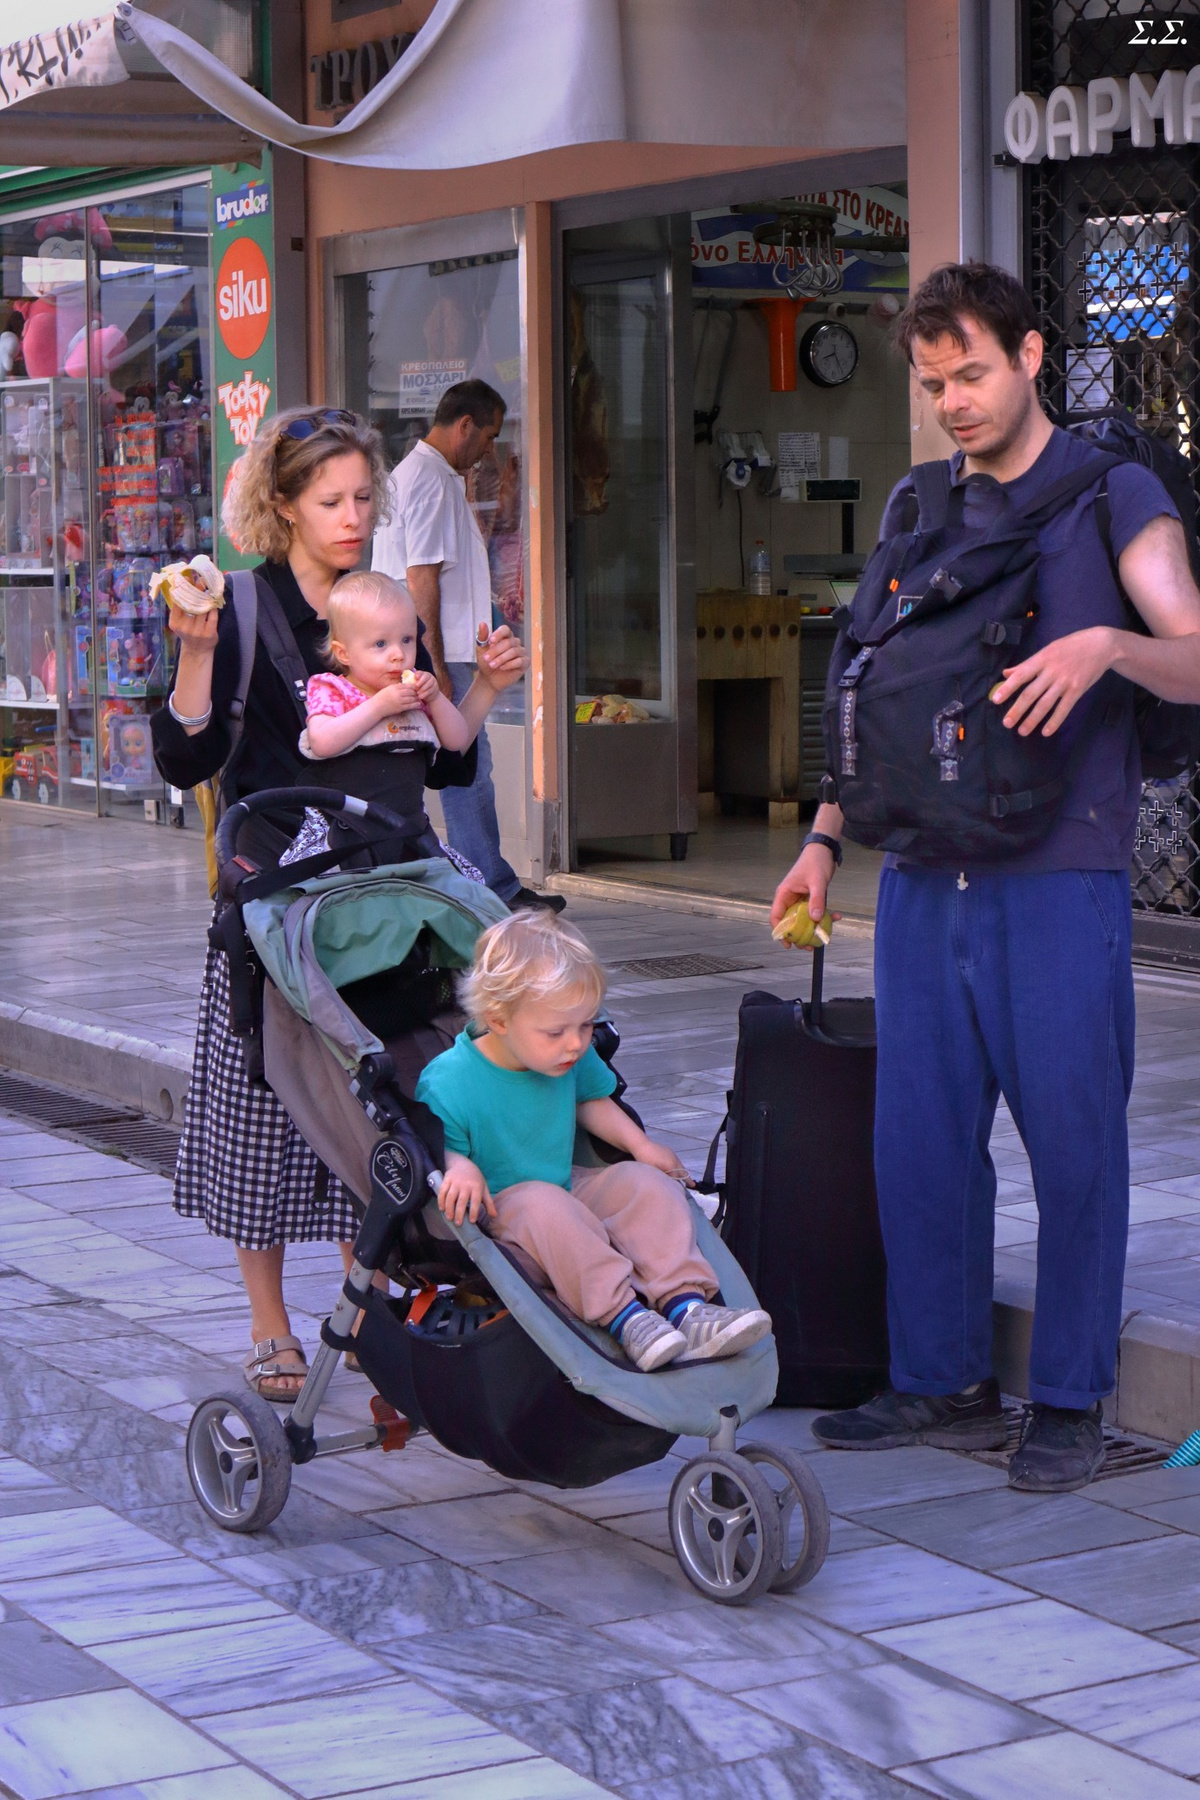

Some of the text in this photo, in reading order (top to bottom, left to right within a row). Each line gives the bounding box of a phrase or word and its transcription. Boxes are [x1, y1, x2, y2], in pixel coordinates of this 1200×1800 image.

[217, 192, 268, 223] bruder
[832, 188, 862, 221] ΣΤΟ
[691, 237, 844, 270] όνο Ελλην
[219, 270, 267, 321] siku
[401, 360, 465, 371] ΚΡΕΟΠΩΛΕΙΟ
[403, 372, 464, 389] ΜΟΣΧΑΡΙ
